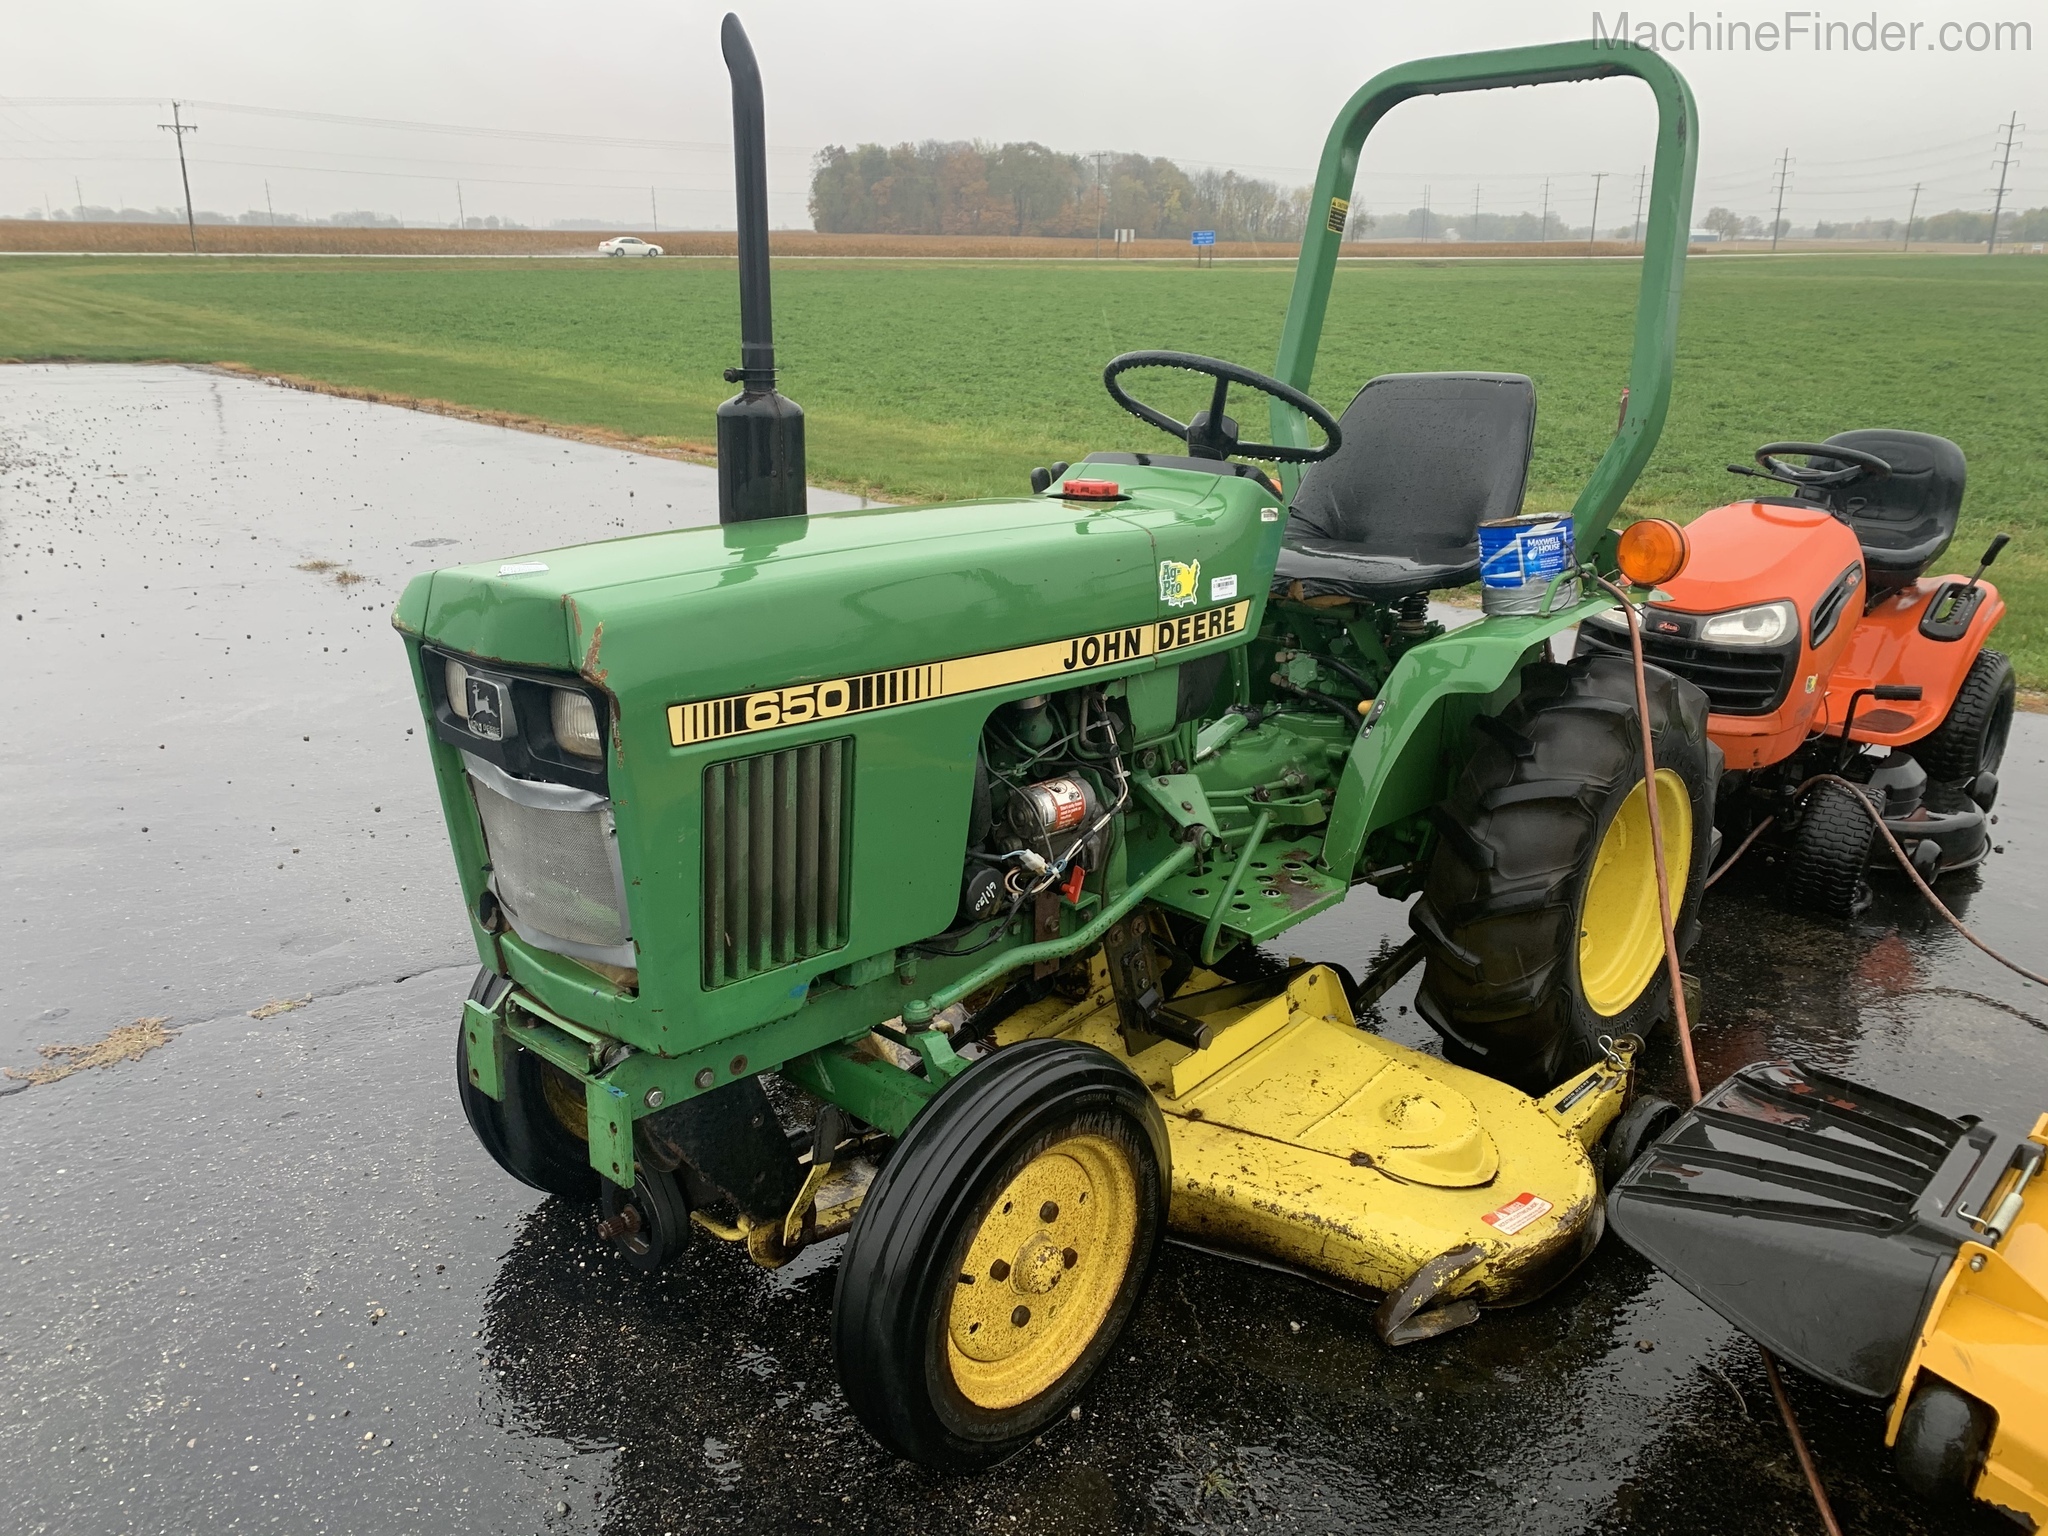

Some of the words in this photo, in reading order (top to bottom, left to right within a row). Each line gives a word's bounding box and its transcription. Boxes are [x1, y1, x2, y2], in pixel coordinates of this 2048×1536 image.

[1527, 537, 1560, 548] MAXWELL
[1538, 543, 1560, 554] HOUSE
[1162, 581, 1182, 597] Pro
[1063, 628, 1141, 670] JOHN
[1158, 605, 1236, 650] DEERE
[745, 681, 850, 730] 650
